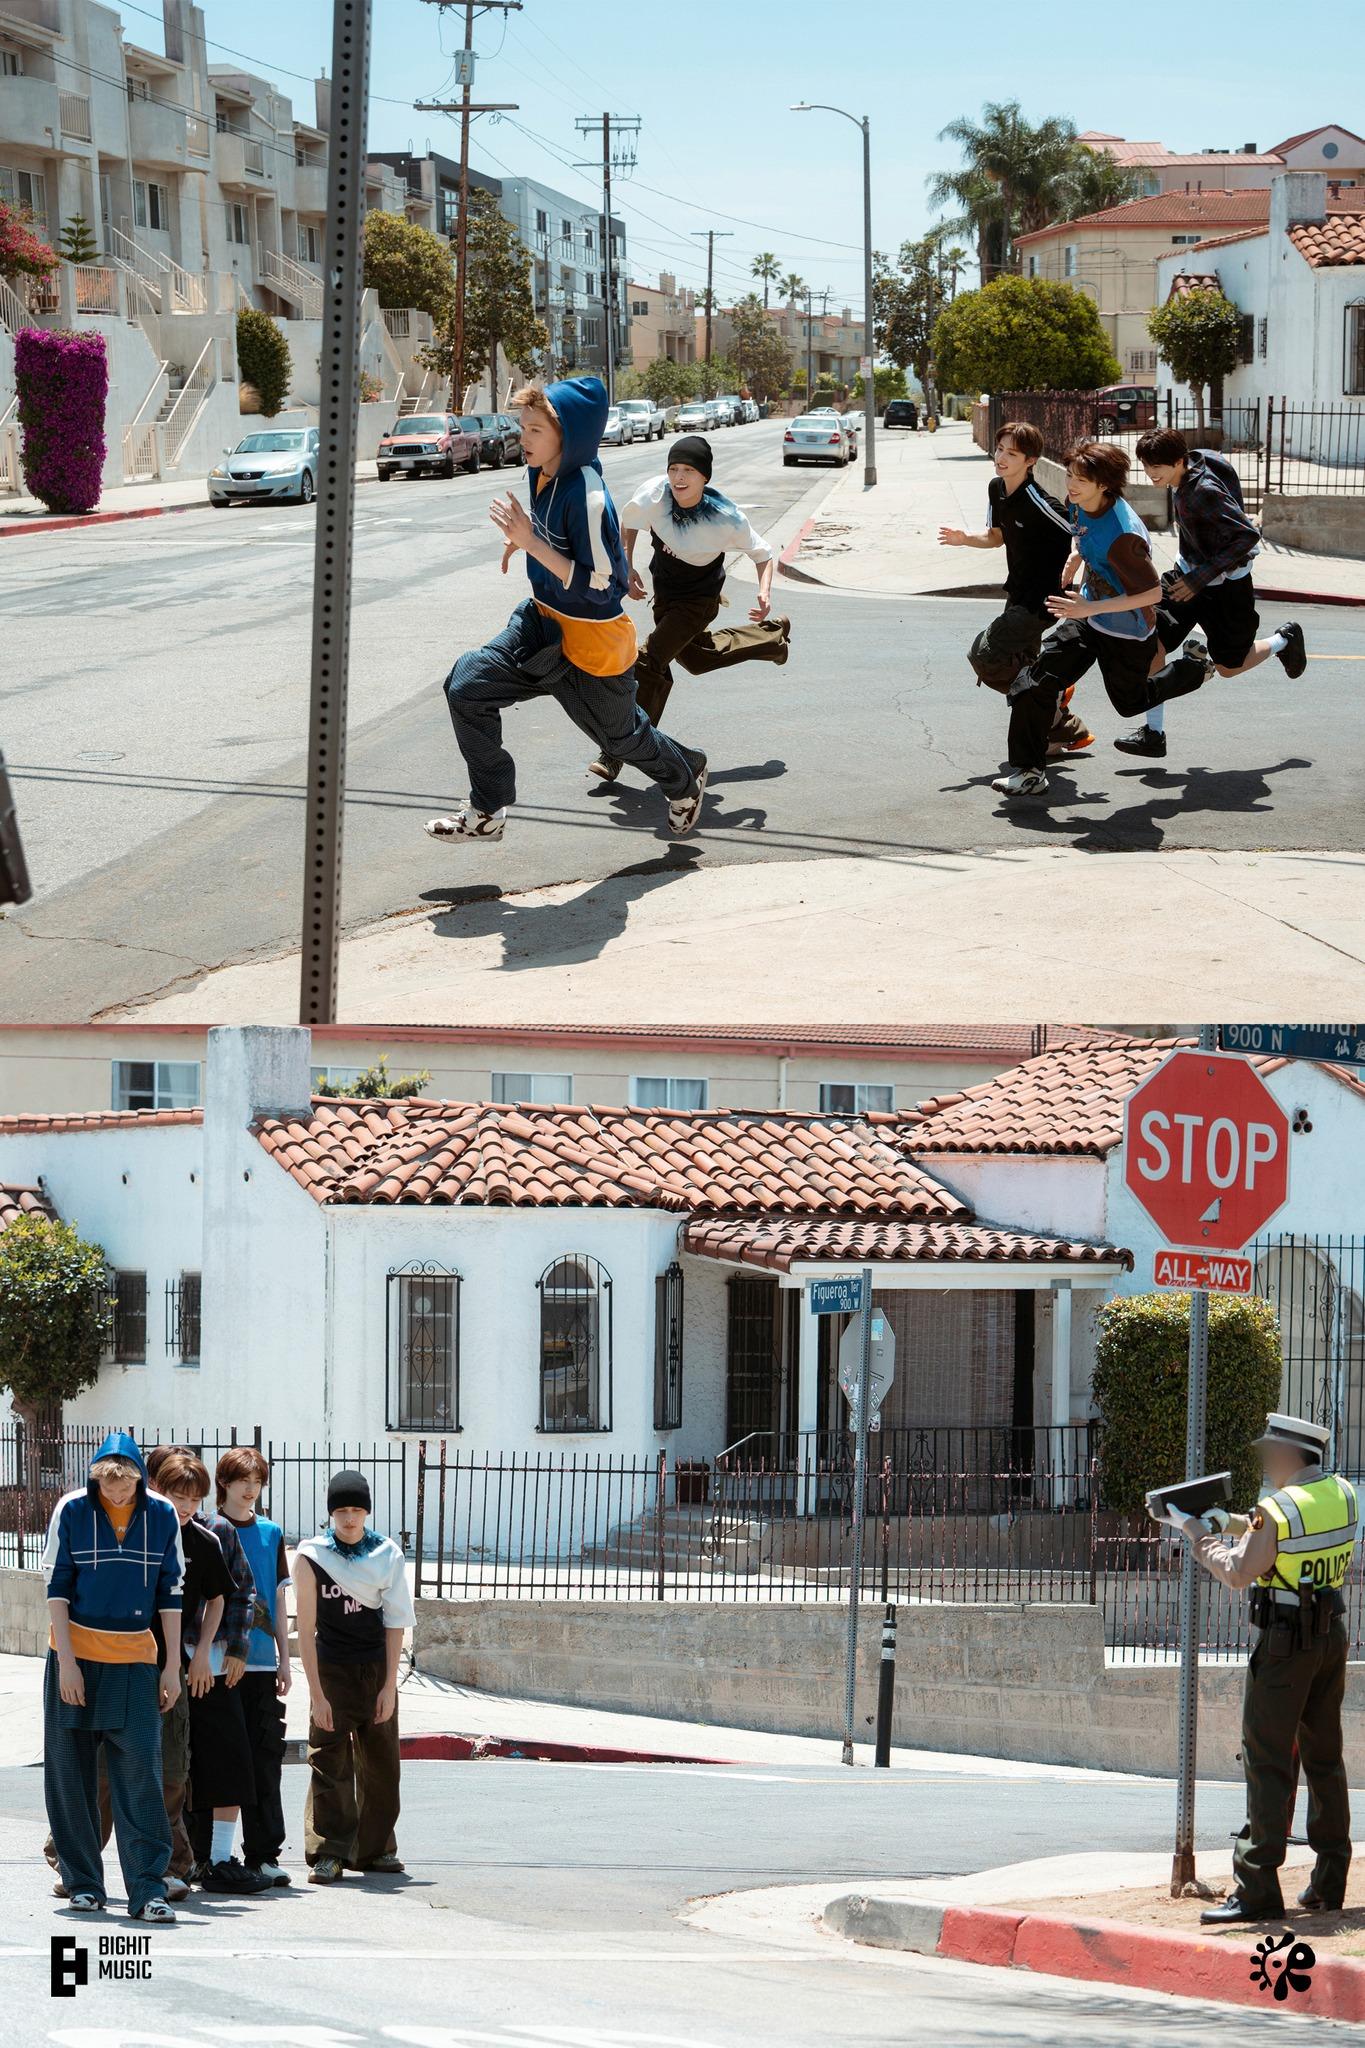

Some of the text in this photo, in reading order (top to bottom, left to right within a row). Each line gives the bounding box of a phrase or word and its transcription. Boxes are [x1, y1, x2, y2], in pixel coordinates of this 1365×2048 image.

[1228, 1025, 1263, 1049] 900
[1271, 1029, 1283, 1051] N
[1137, 1110, 1278, 1190] STOP
[1157, 1257, 1250, 1287] ALL-WAY
[813, 1281, 860, 1304] Figueroa Ter
[840, 1298, 852, 1310] 900
[1300, 1551, 1351, 1586] POLICE
[343, 1599, 363, 1615] ME
